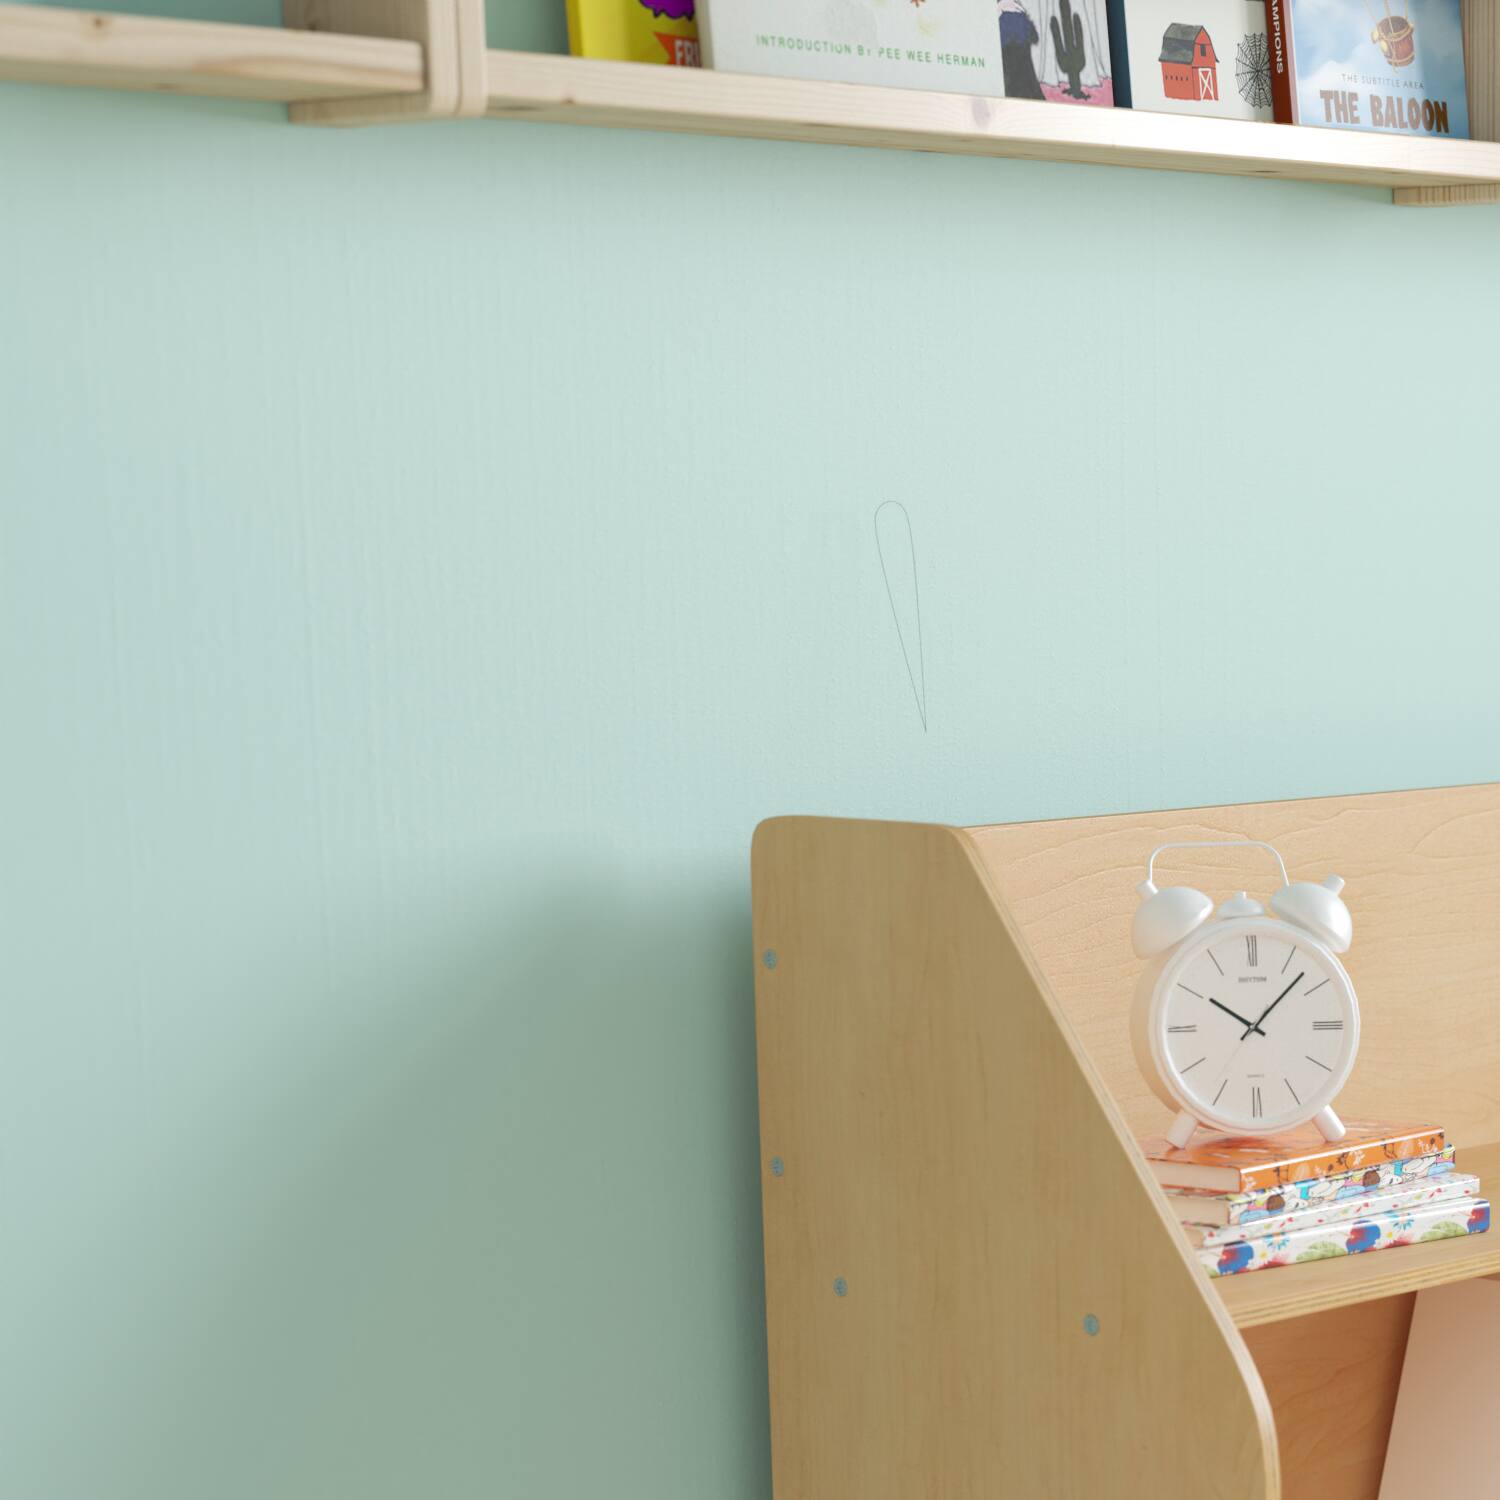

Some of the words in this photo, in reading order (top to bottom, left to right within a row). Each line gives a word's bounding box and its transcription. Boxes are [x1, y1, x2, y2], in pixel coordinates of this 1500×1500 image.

[756, 34, 852, 54] INTRODUCTION
[878, 47, 902, 60] PEE
[907, 50, 932, 63] WEE
[937, 53, 986, 68] HERMAN
[1342, 73, 1358, 84] THE
[1361, 76, 1401, 88] SUBTITLE
[1403, 80, 1425, 90] AREA
[1319, 89, 1361, 125] THE
[1369, 94, 1450, 134] BALOON
